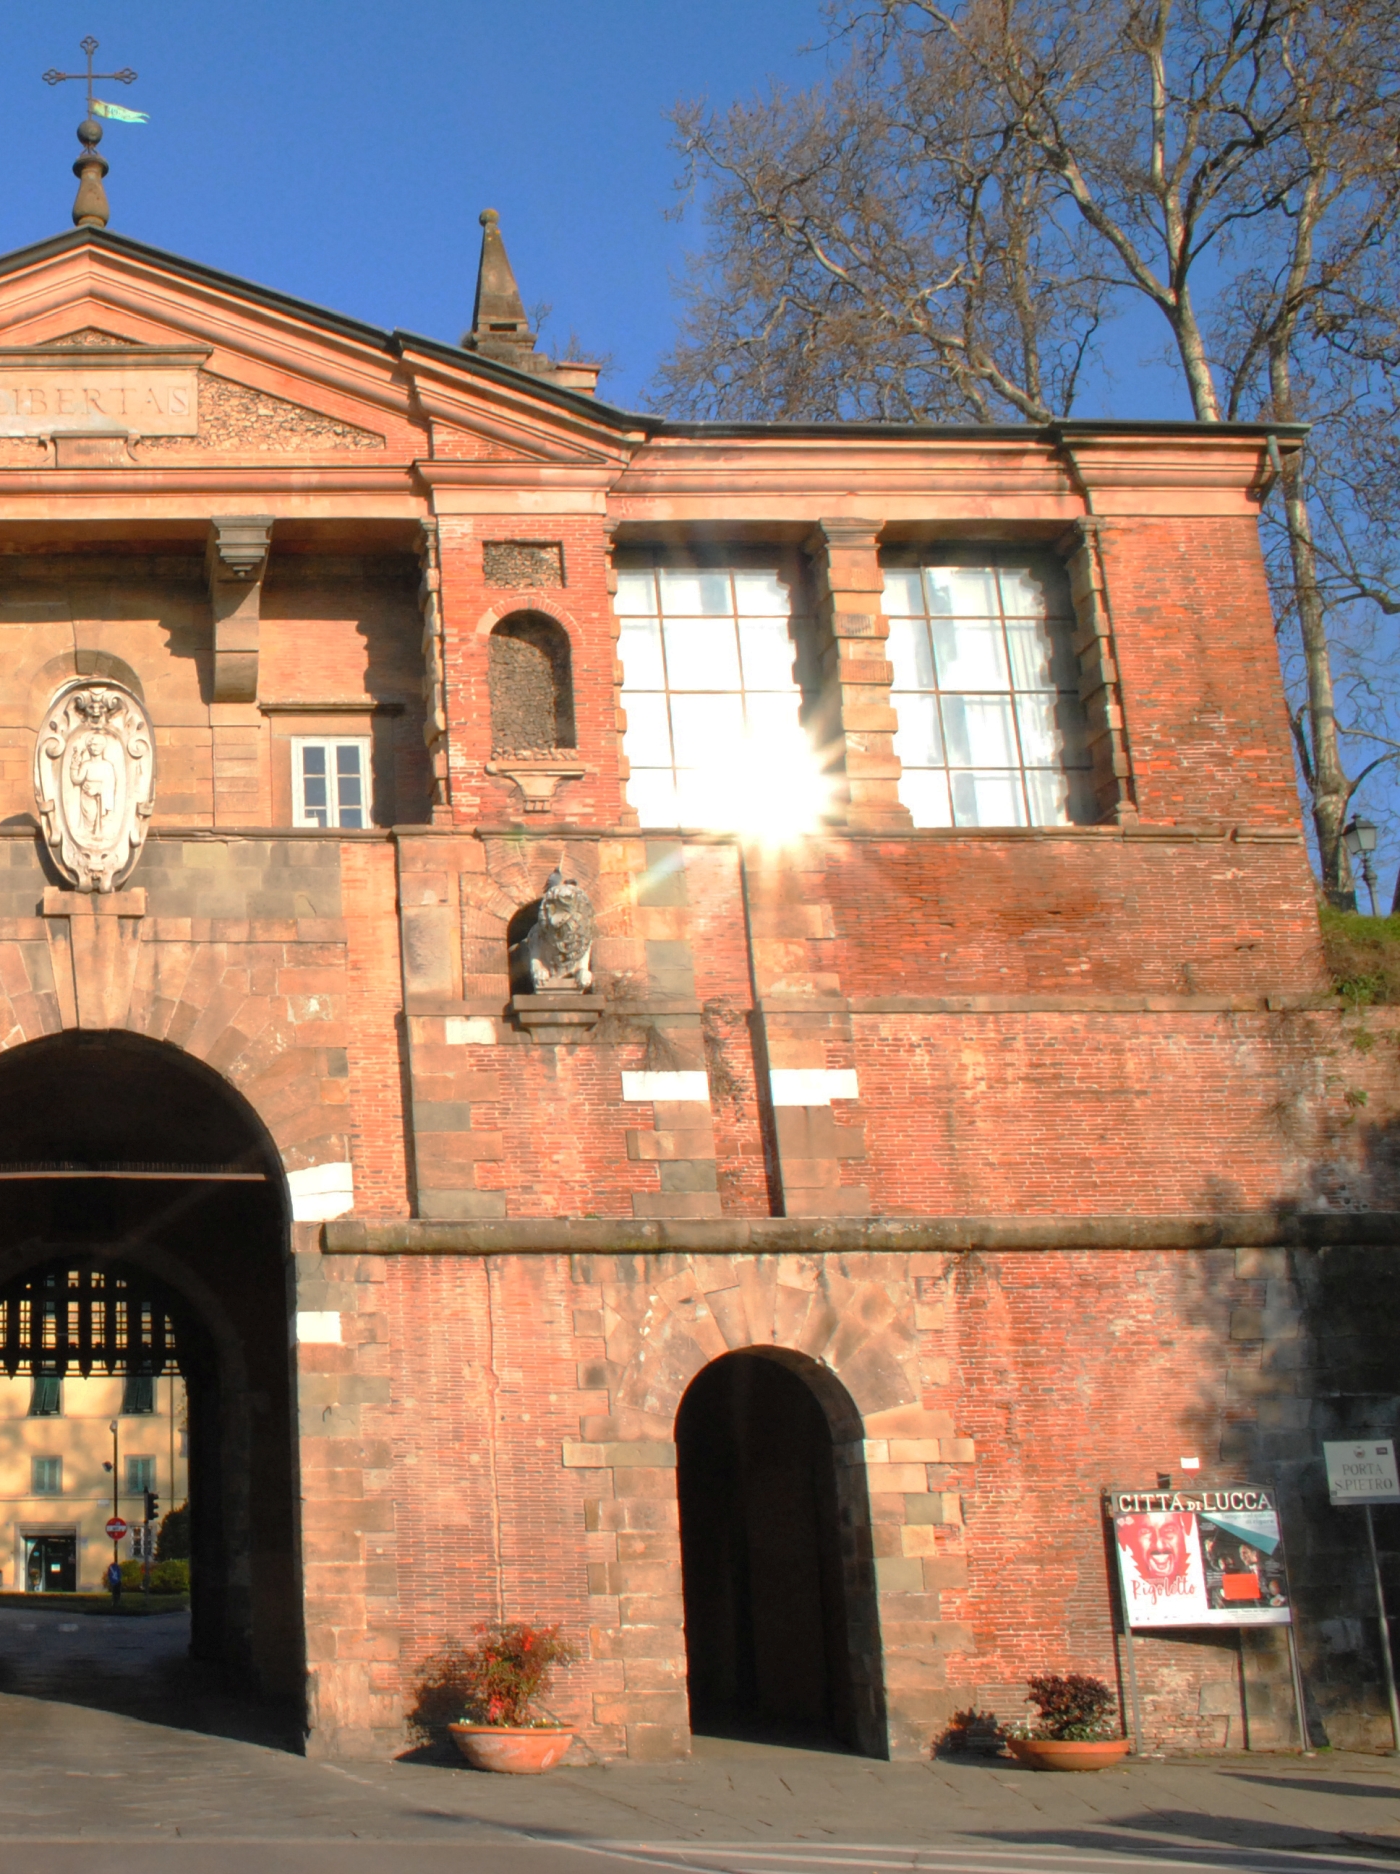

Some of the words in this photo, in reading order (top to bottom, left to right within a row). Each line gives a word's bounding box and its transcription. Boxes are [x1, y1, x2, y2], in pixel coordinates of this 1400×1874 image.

[1342, 1463, 1383, 1475] PORTA
[1187, 1500, 1201, 1510] DI
[1202, 1492, 1273, 1511] LUCCA
[1131, 1575, 1196, 1605] Rigoletto
